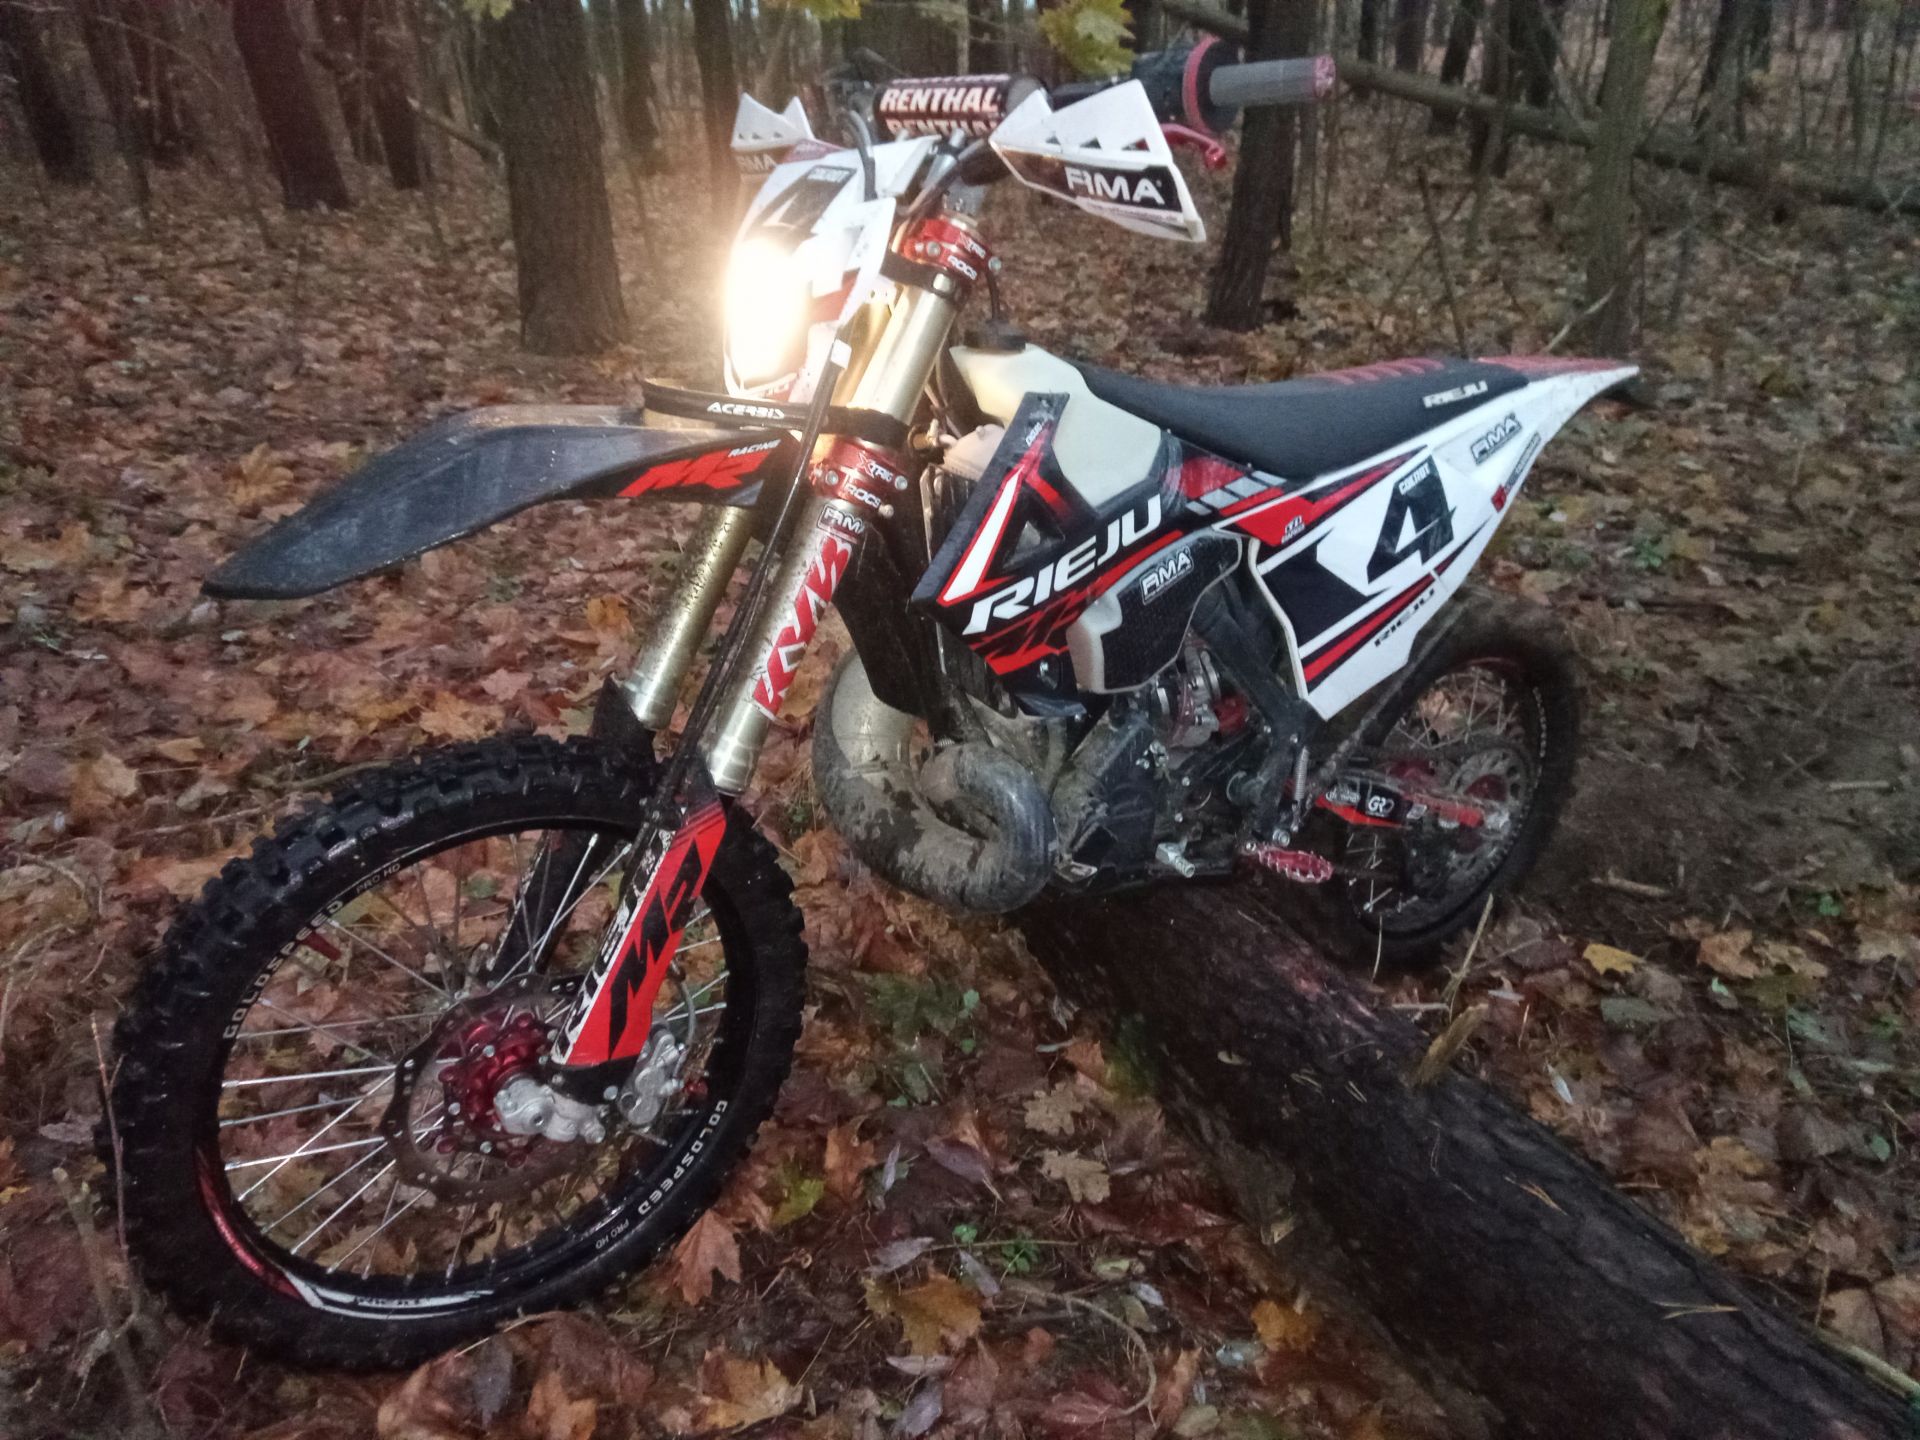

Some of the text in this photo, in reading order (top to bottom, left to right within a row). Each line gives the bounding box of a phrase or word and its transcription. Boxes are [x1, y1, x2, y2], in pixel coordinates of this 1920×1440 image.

[879, 86, 999, 113] RENTHAL
[706, 402, 785, 420] ACERBIS
[727, 439, 782, 458] RACING
[961, 494, 1163, 636] RIEJU
[1366, 455, 1455, 585] 4
[222, 863, 402, 1040] GOLDSPEED PRO HD
[595, 1100, 728, 1250] GOLDSPEED PRO HD
